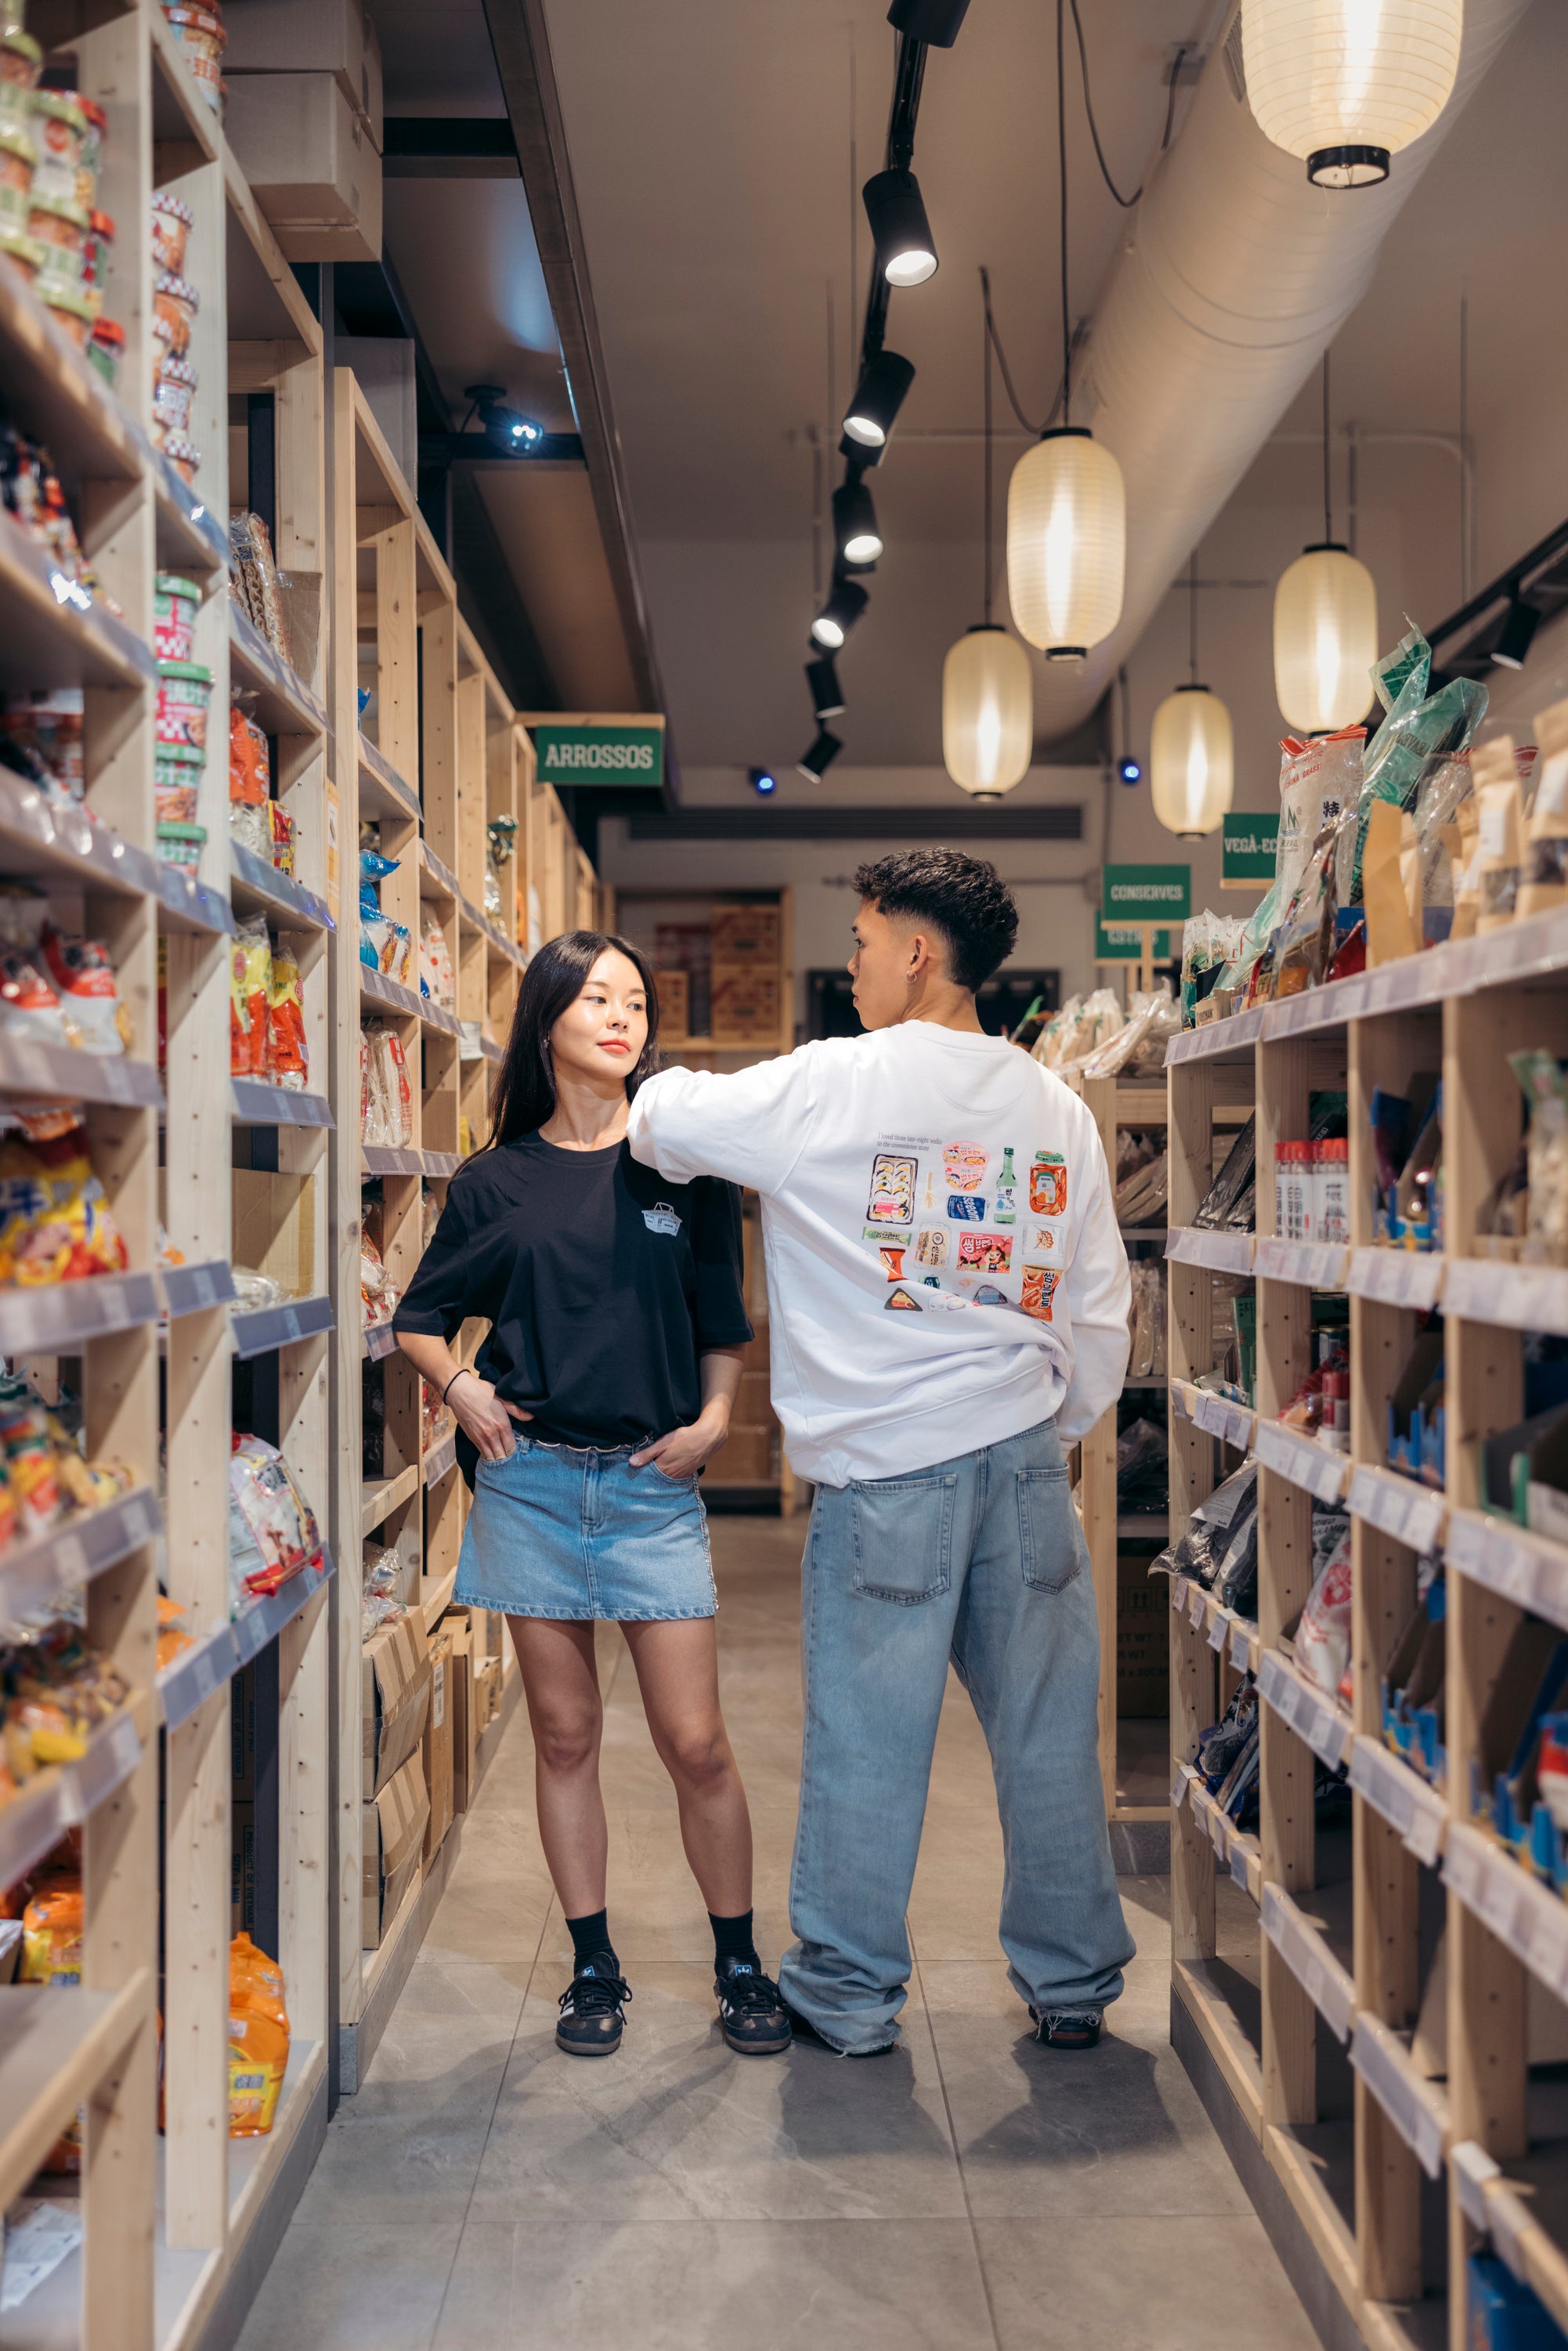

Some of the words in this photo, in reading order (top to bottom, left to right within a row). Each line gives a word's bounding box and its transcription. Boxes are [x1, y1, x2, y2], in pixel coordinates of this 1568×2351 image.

[544, 743, 653, 769] ARROSSOS
[1223, 834, 1277, 854] VEGÀ-EC
[1111, 884, 1184, 902] CONSERVES
[907, 1135, 929, 1145] late-night
[1313, 1517, 1335, 1527] RIED
[1118, 1633, 1132, 1642] ET
[234, 1723, 241, 1733] OF
[247, 1873, 254, 1884] OF
[232, 1887, 240, 1904] MM
